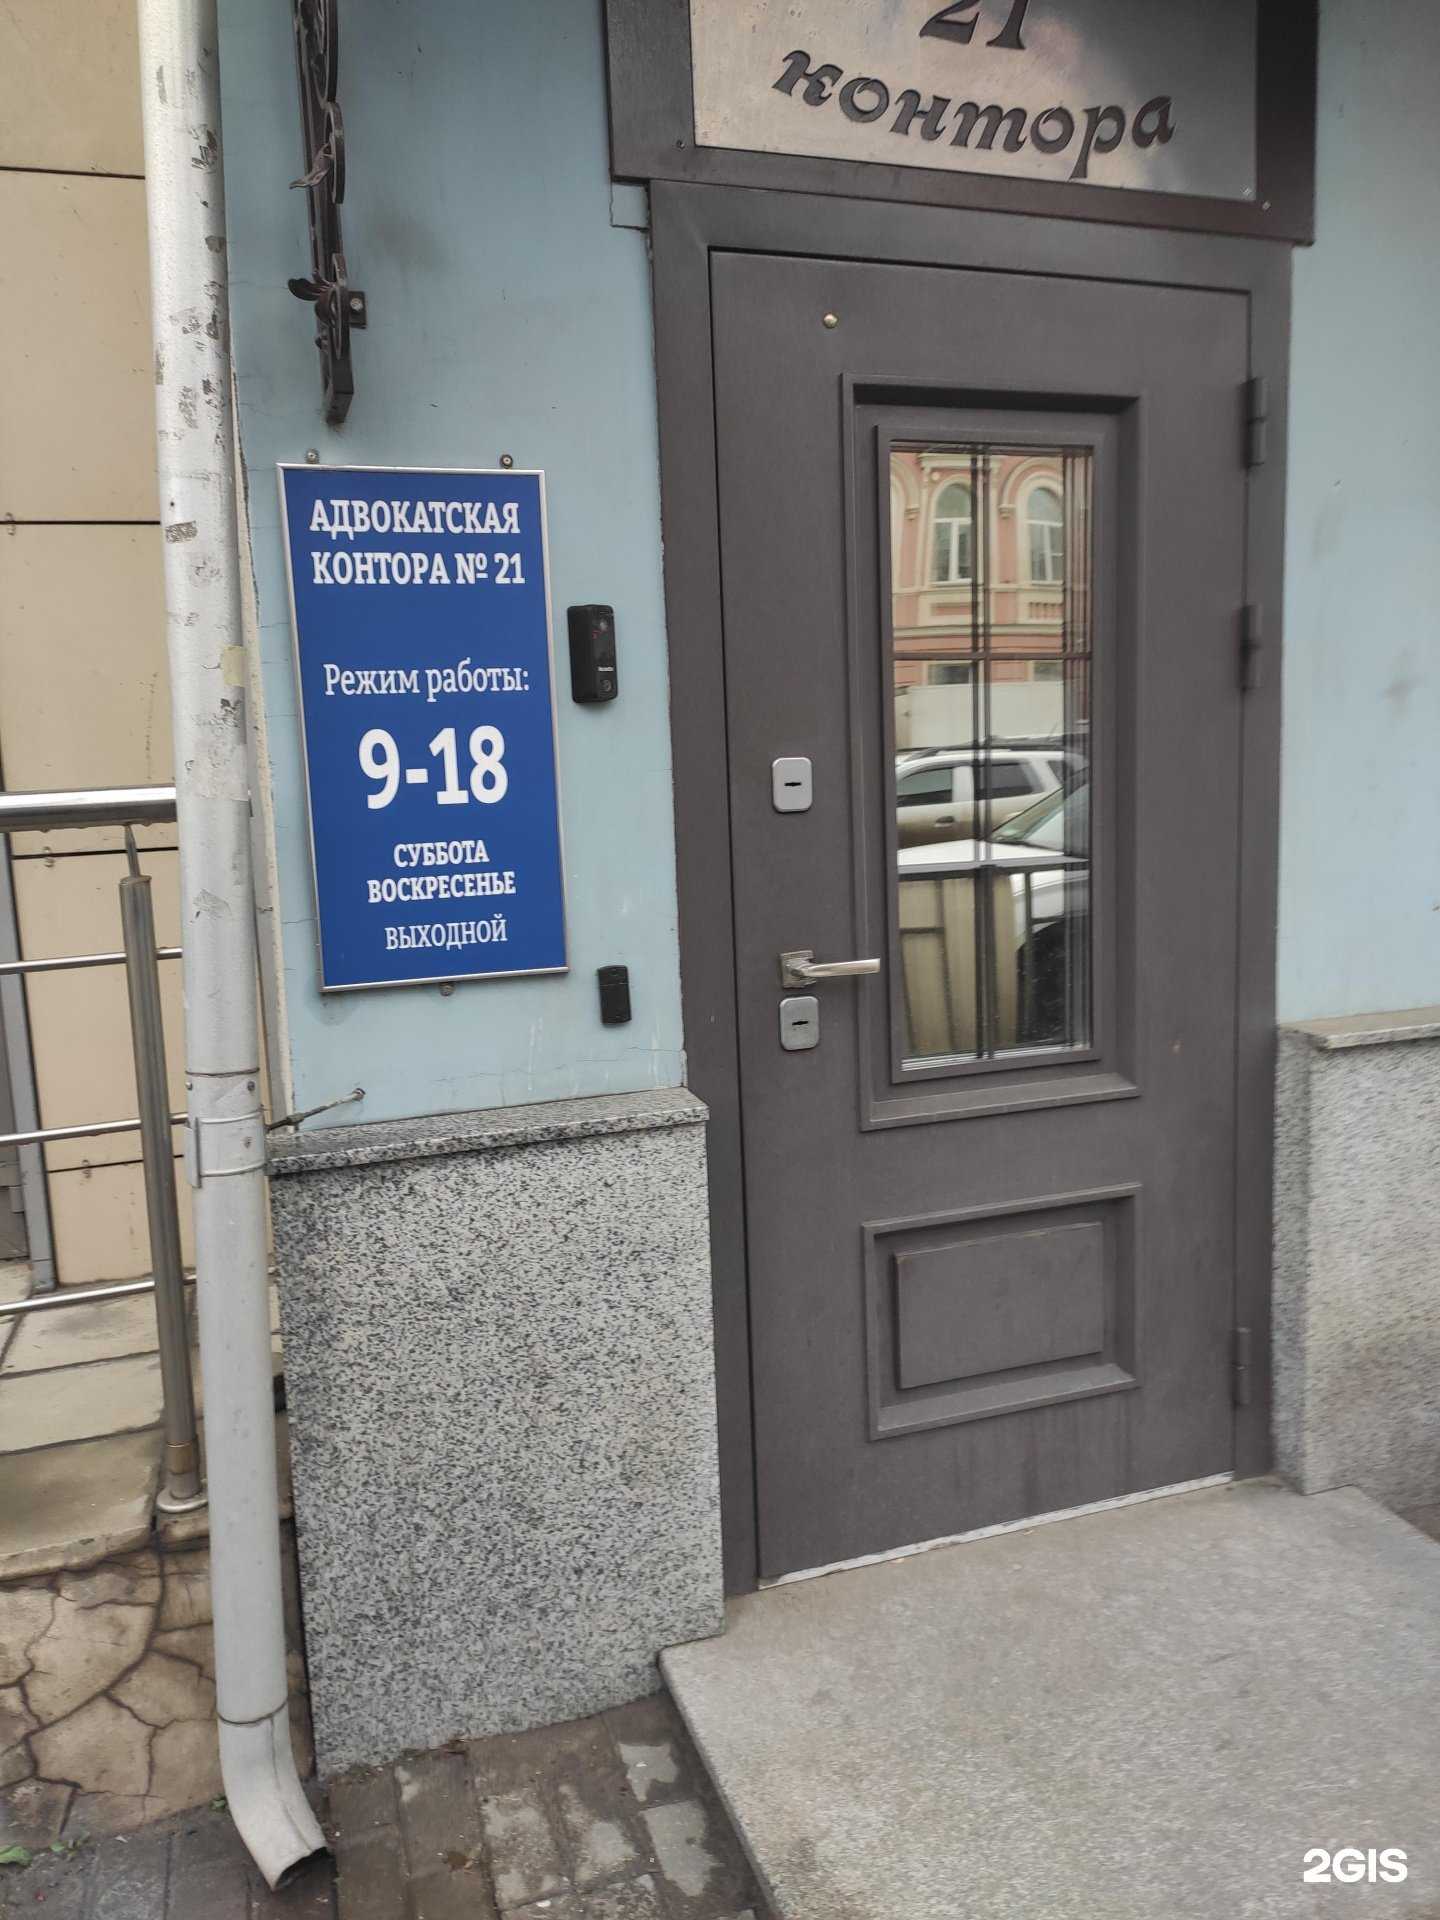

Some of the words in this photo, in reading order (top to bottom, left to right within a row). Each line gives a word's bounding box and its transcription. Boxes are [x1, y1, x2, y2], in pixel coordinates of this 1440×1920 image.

[771, 49, 1177, 181] контора
[309, 499, 521, 541] АДВОКАТСКАЯ
[311, 551, 451, 585] КОНТОРА
[323, 663, 419, 696] Режим
[424, 657, 530, 703] работы:
[358, 725, 509, 810] 9-18
[393, 839, 490, 868] СУББОТА
[367, 871, 517, 904] ВОСКРЕСЕНЬЕ
[384, 914, 508, 951] ВЫХОДНОЙ
